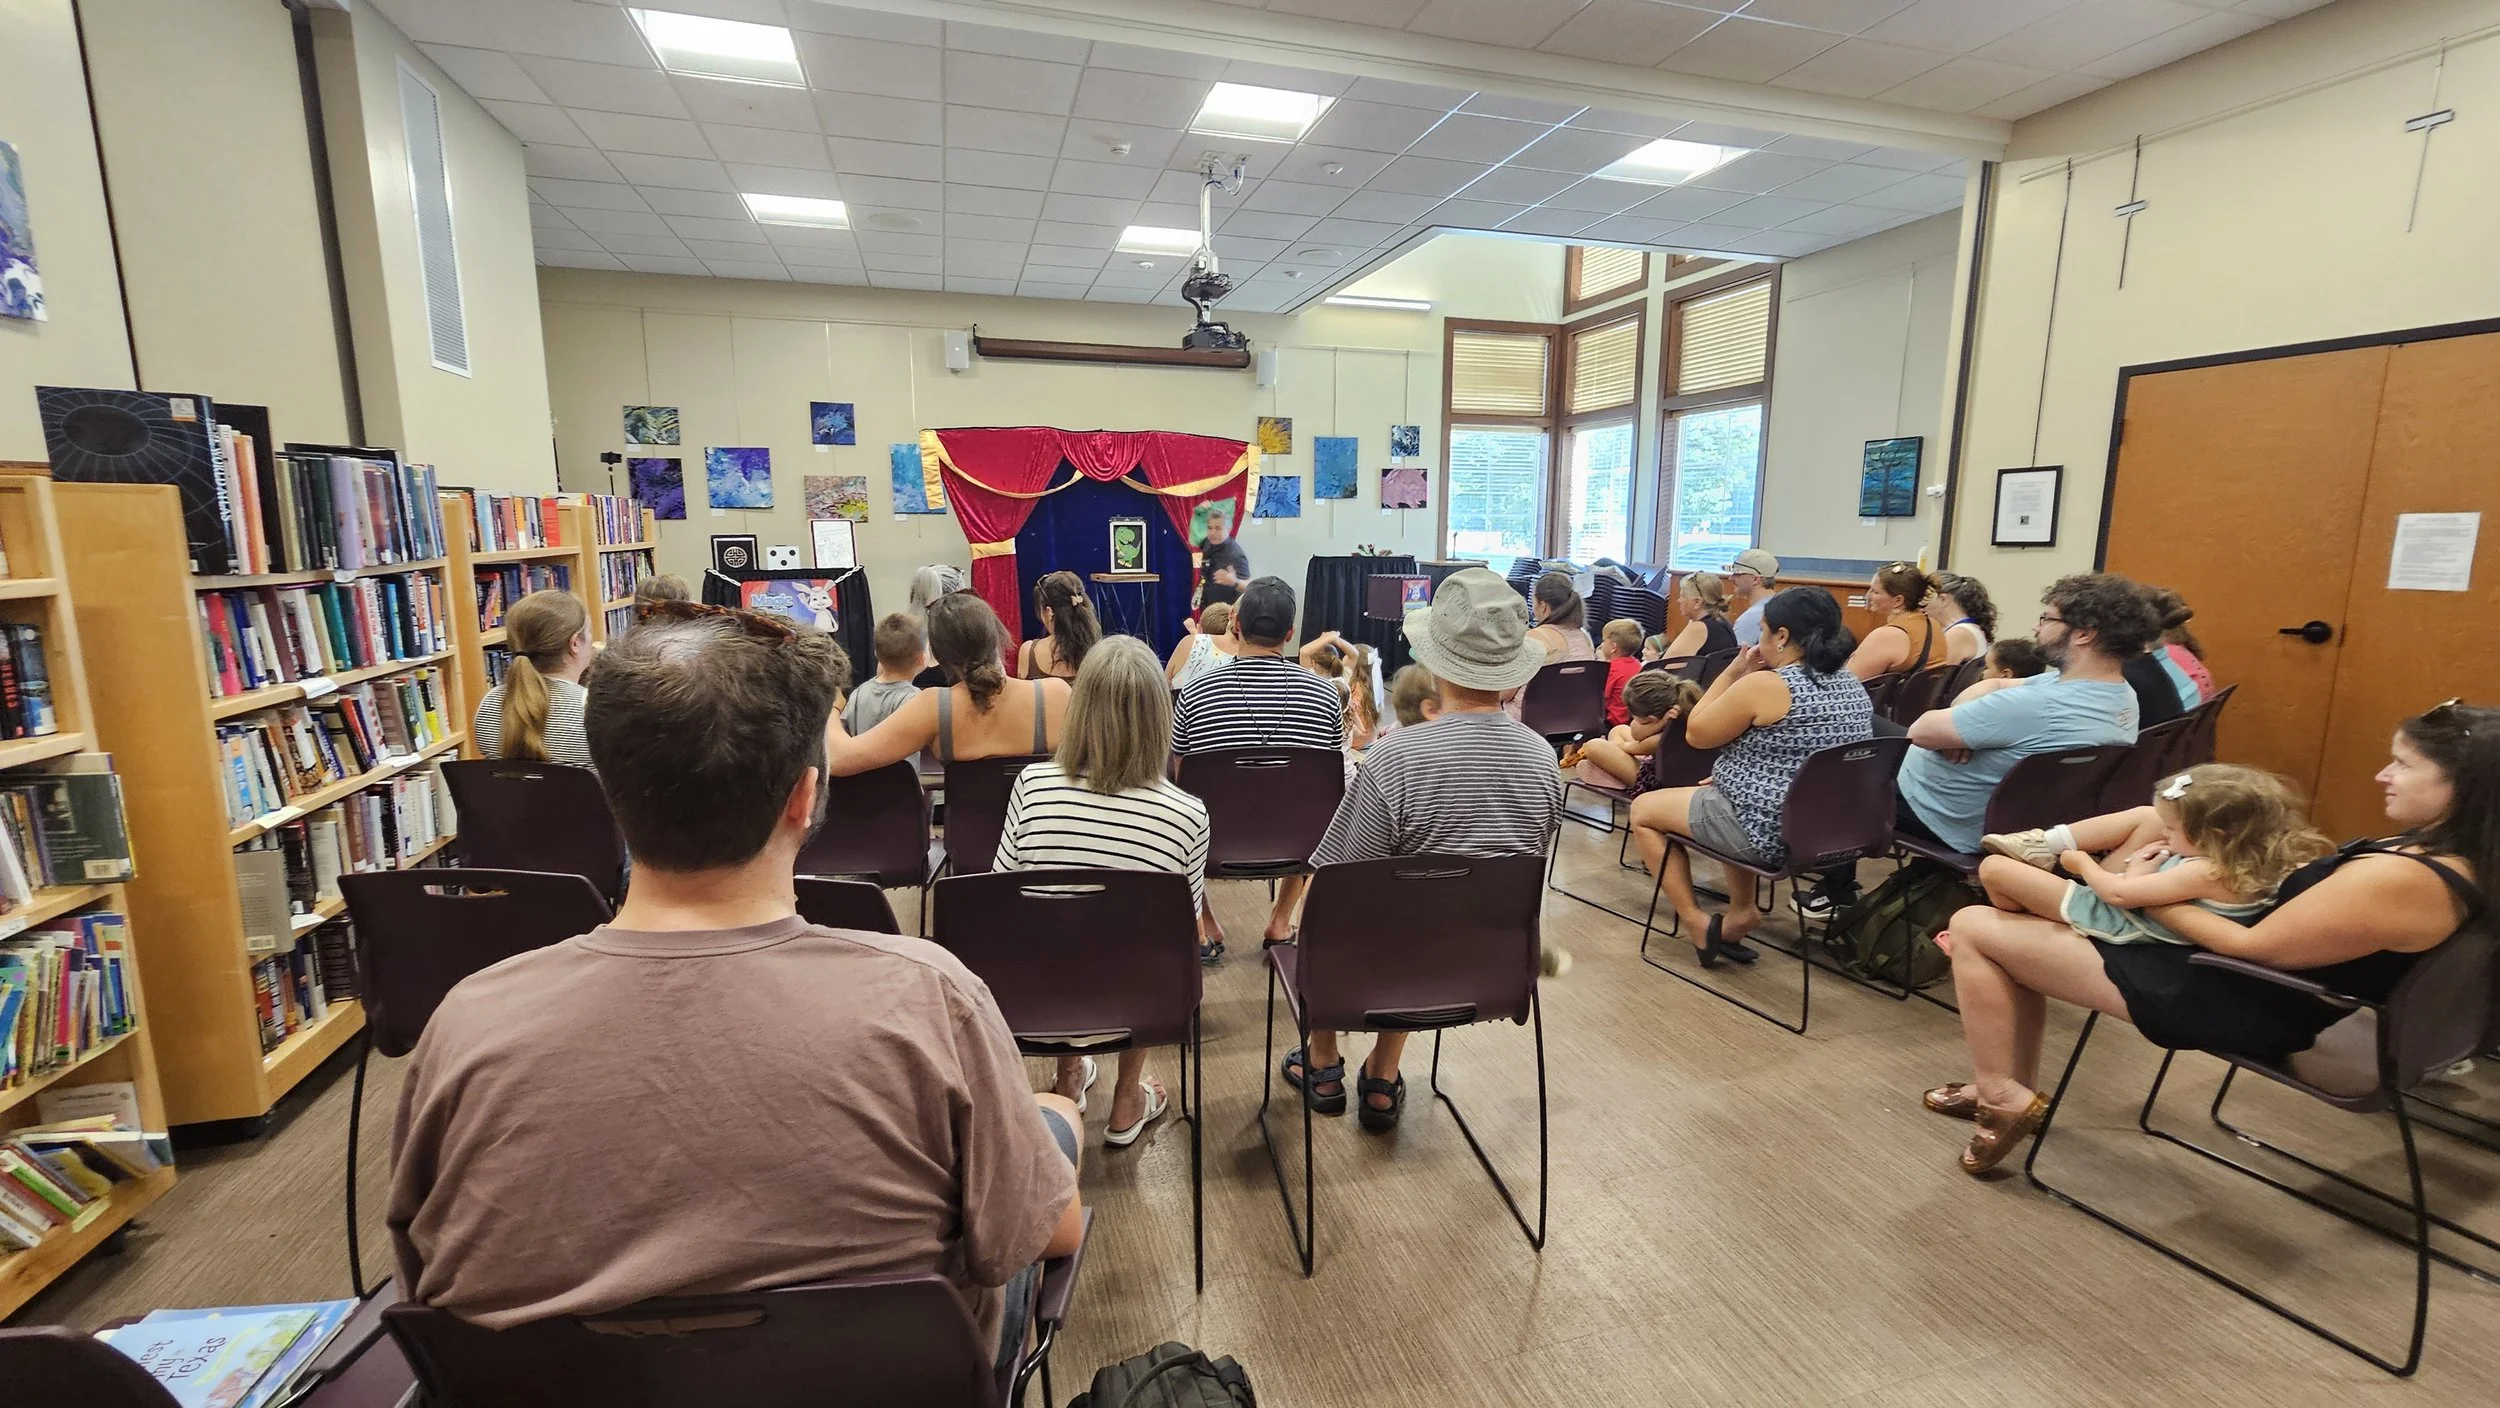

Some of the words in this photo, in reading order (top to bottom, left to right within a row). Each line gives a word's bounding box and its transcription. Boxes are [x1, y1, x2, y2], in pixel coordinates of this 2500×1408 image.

[210, 449, 226, 485] WORLD
[216, 486, 232, 521] ATLAS
[751, 593, 793, 609] Magic
[164, 1336, 227, 1383] Texas
